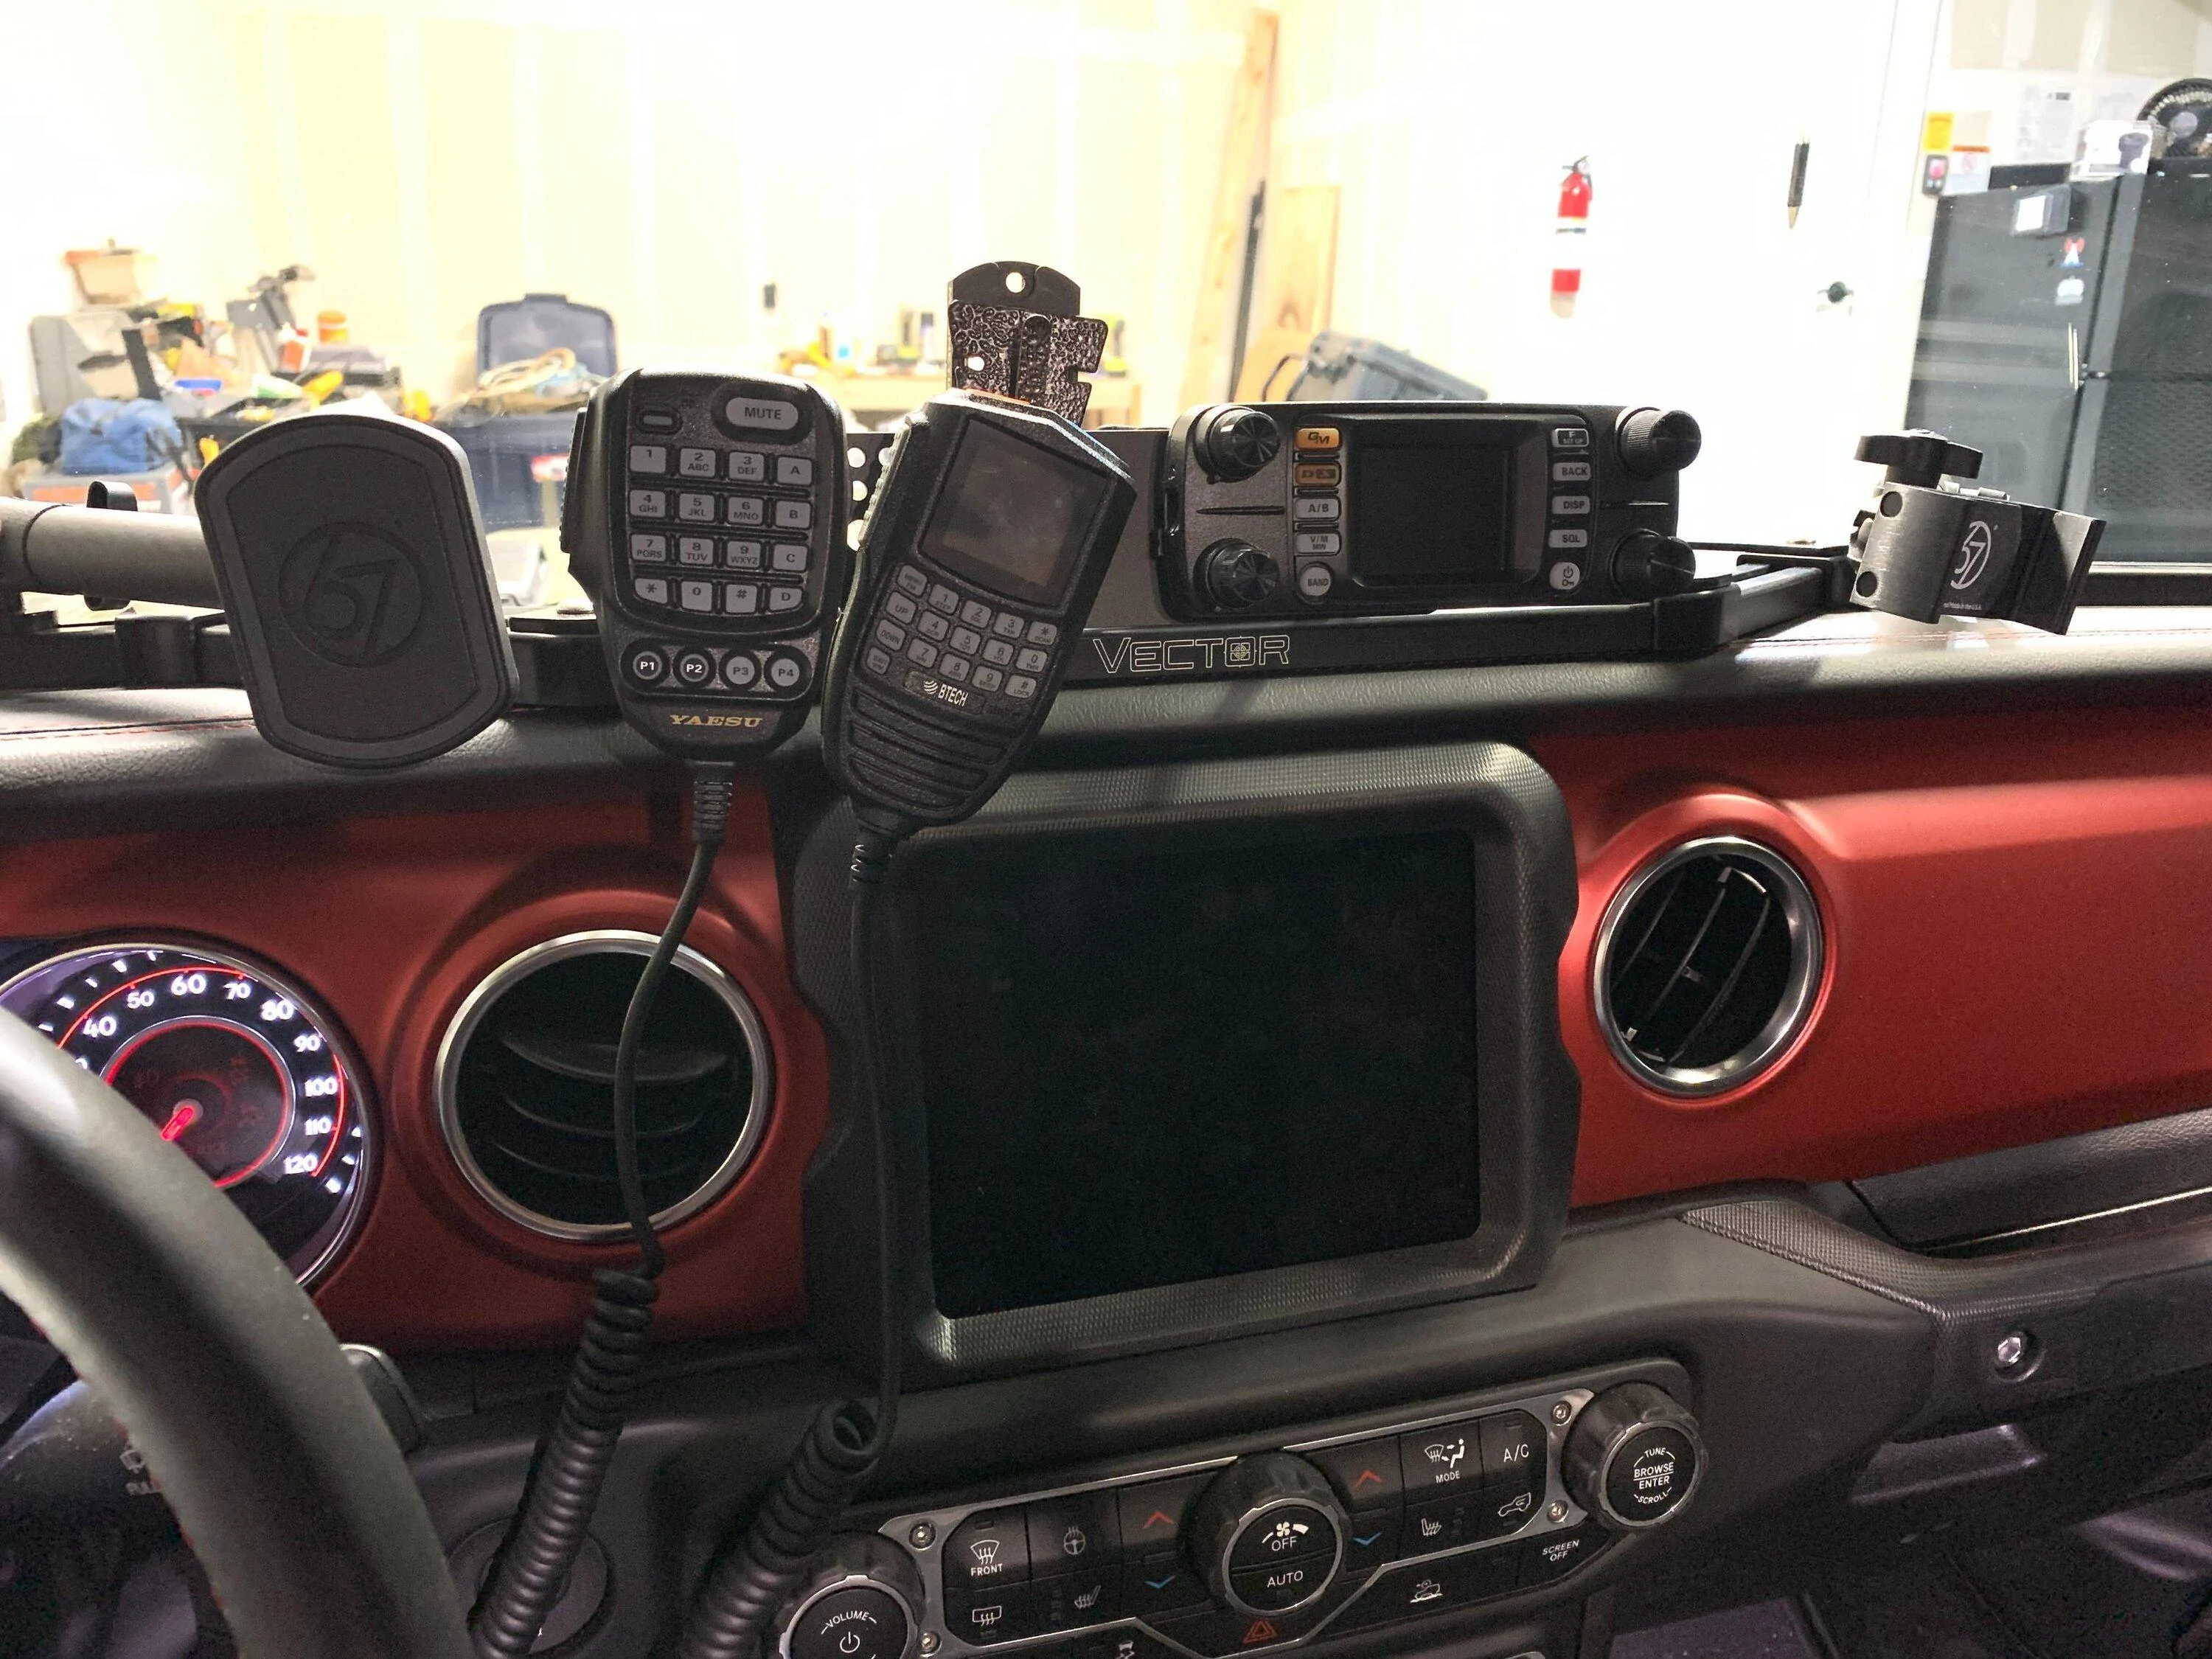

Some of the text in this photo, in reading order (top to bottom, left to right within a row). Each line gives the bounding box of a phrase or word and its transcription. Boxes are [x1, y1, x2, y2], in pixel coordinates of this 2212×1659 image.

[744, 406, 782, 420] MUTE
[647, 449, 653, 459] 1
[695, 453, 703, 462] 2
[743, 456, 752, 465] 3
[688, 463, 709, 472] ABC
[737, 467, 757, 475] DEF
[790, 466, 801, 476] A
[1562, 467, 1588, 476] BACK
[643, 495, 652, 503] 4
[693, 498, 702, 507] 5
[639, 505, 658, 513] GHI
[742, 501, 751, 510] 6
[1308, 504, 1329, 513] A/B
[1563, 501, 1585, 509] DISP
[688, 509, 706, 517] JKL
[733, 512, 759, 521] MNO
[789, 509, 799, 519] B
[646, 539, 653, 548] 7
[1562, 535, 1580, 543] SQL
[692, 543, 701, 552] 8
[740, 546, 749, 554] 9
[686, 553, 708, 561] TUV
[731, 556, 758, 564] WXYZ
[786, 553, 795, 563] C
[1307, 578, 1329, 586] BAND
[736, 589, 748, 599] #
[781, 592, 791, 602] D
[894, 604, 908, 615] UP
[975, 607, 983, 618] 2
[932, 621, 939, 630] 4
[880, 629, 900, 645] DOWN
[964, 635, 971, 645] 5
[922, 647, 930, 657] 7
[1092, 635, 1290, 674] VECTOR
[640, 661, 655, 671] P1
[686, 664, 703, 674] P2
[732, 666, 749, 676] P3
[953, 662, 961, 671] 8
[778, 668, 794, 678] P4
[986, 672, 994, 682] 9
[938, 684, 969, 707] BTECH
[669, 714, 764, 728] YAESU
[170, 974, 208, 996] 60
[224, 982, 251, 1001] 70
[127, 990, 155, 1009] 50
[260, 1001, 295, 1021] 80
[83, 1016, 117, 1037] 40
[293, 1034, 321, 1053] 90
[305, 1077, 338, 1096] 100
[305, 1119, 331, 1137] 110
[284, 1156, 318, 1175] 120
[1503, 1444, 1530, 1464] A/C
[1644, 1447, 1666, 1458] TUNE
[1634, 1461, 1674, 1478] BROWSE
[1436, 1470, 1461, 1484] MODE
[1638, 1475, 1670, 1490] ENTER
[1638, 1491, 1669, 1504] SCROLL
[1271, 1536, 1298, 1552] OFF
[1543, 1539, 1580, 1557] SCREEN
[1549, 1550, 1569, 1562] OFF
[970, 1563, 1004, 1576] FRONT
[1267, 1570, 1304, 1589] AUTO
[826, 1610, 870, 1628] VOLUME
